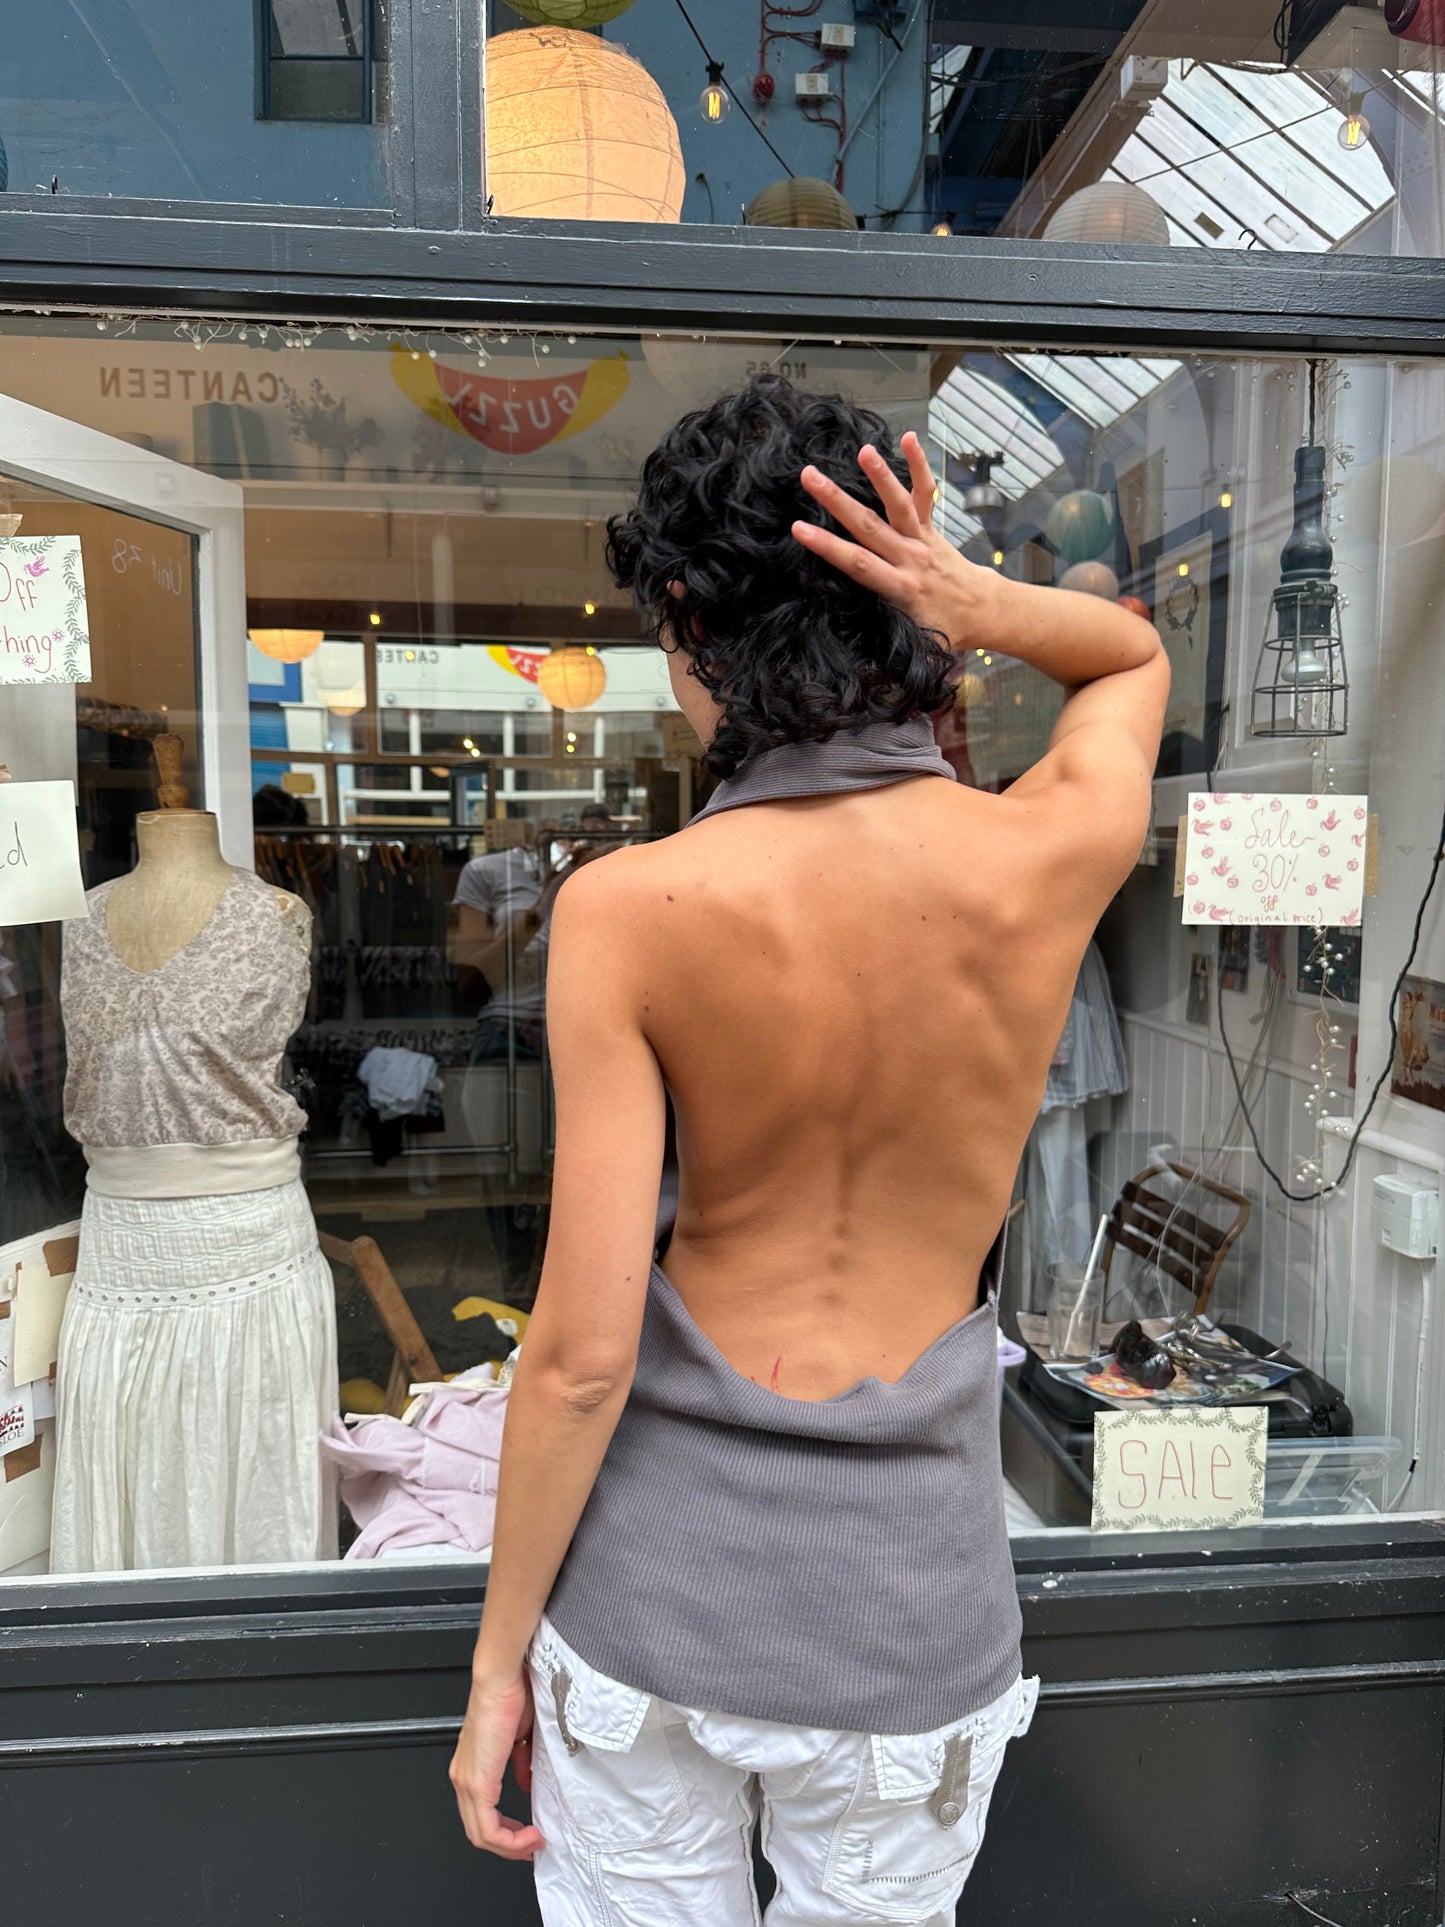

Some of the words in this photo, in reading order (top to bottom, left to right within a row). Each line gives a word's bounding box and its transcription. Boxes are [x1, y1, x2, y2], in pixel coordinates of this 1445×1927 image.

[0, 625, 52, 673] hing
[1244, 807, 1317, 849] Sale
[1252, 853, 1299, 892] 30%
[1260, 895, 1279, 912] off
